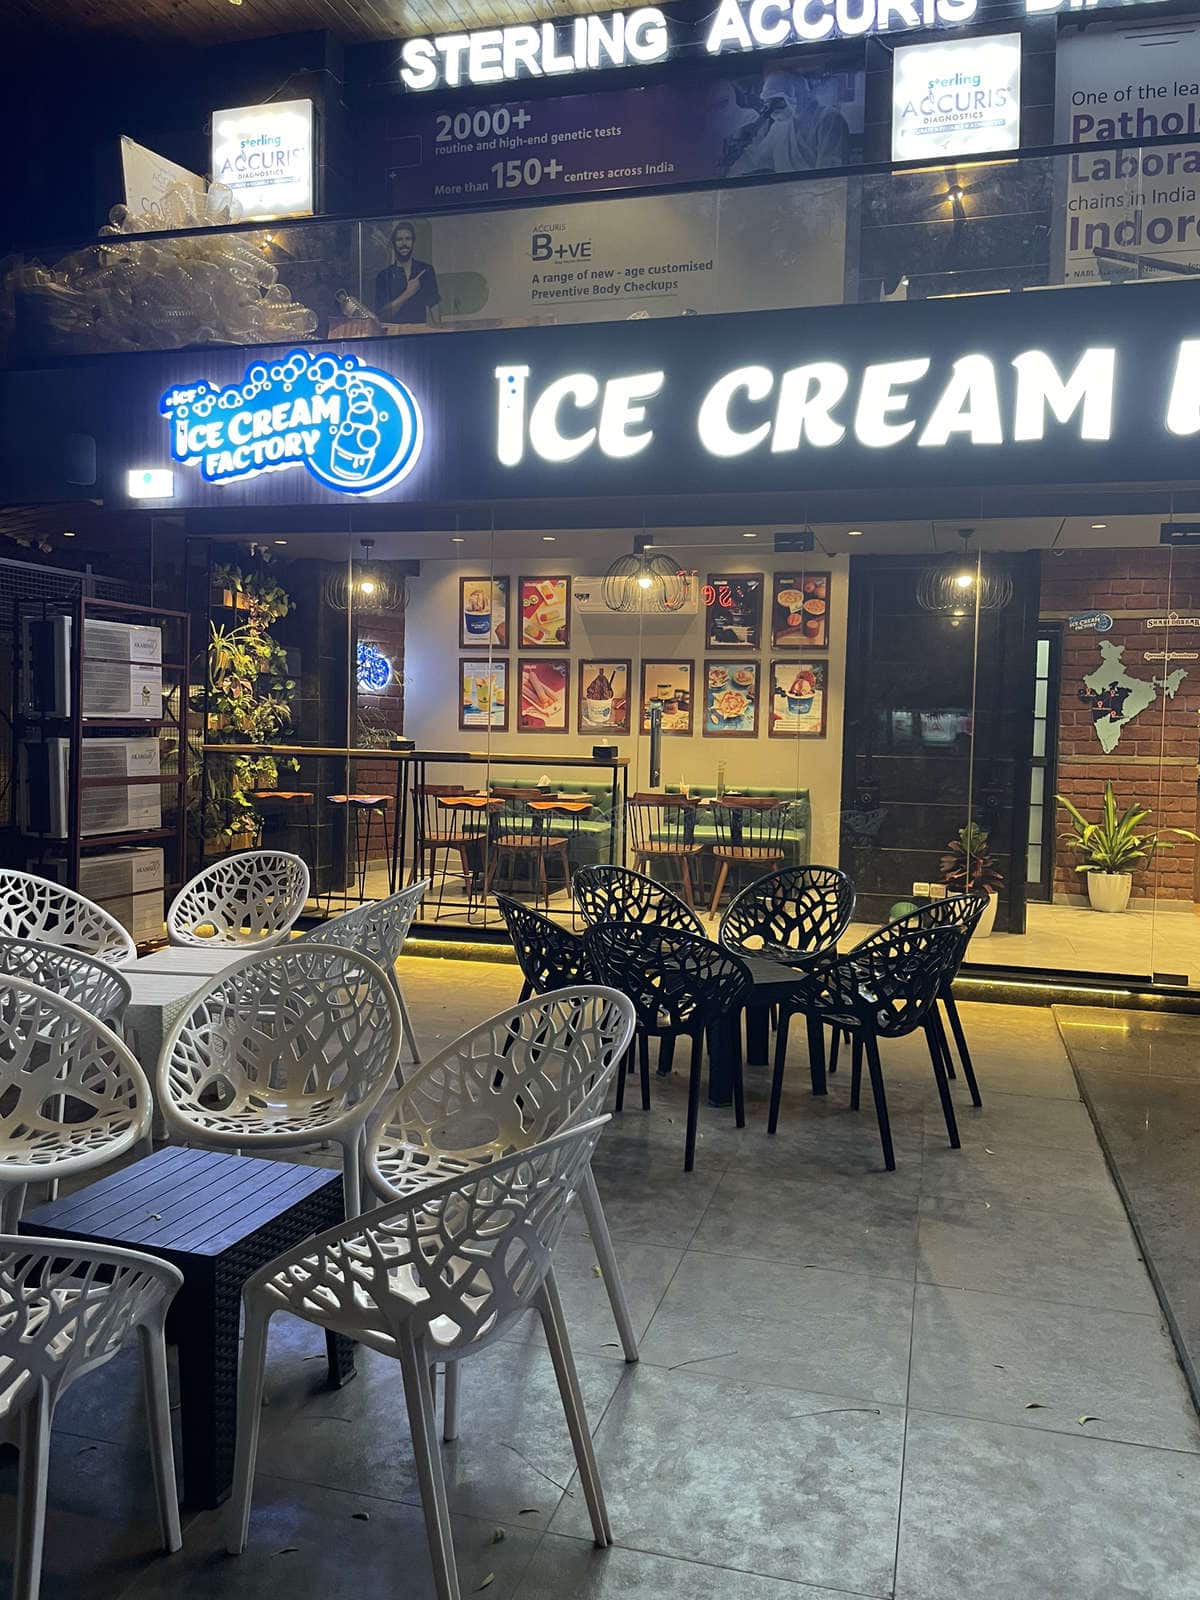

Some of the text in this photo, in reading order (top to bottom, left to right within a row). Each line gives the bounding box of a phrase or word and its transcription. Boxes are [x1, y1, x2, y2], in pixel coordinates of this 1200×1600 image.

[401, 7, 668, 91] STERLING
[901, 87, 1007, 118] ACCURIS
[1072, 81, 1200, 106] One of the lea
[435, 108, 531, 142] 2000+
[923, 111, 984, 124] DIAGNOSTICS
[1073, 103, 1200, 144] Pathol
[435, 125, 622, 155] routine and high-end genetic tests
[239, 169, 284, 179] DIAGNOSTICS
[434, 157, 674, 195] More than 150+ centres across India
[1071, 148, 1200, 183] Labora
[1068, 186, 1196, 211] chains in India
[1070, 210, 1200, 251] Indor
[532, 233, 592, 261] B+VE
[532, 274, 540, 284] A
[543, 271, 573, 285] range
[577, 269, 590, 281] of
[591, 269, 614, 280] new
[624, 266, 645, 278] age
[648, 260, 713, 275] customised
[531, 279, 679, 299] Preventive Body Checkups
[495, 364, 664, 466] ICE
[698, 348, 1116, 458] CREAM
[176, 394, 341, 456] ICE CREAM
[206, 429, 321, 476] FACTORY
